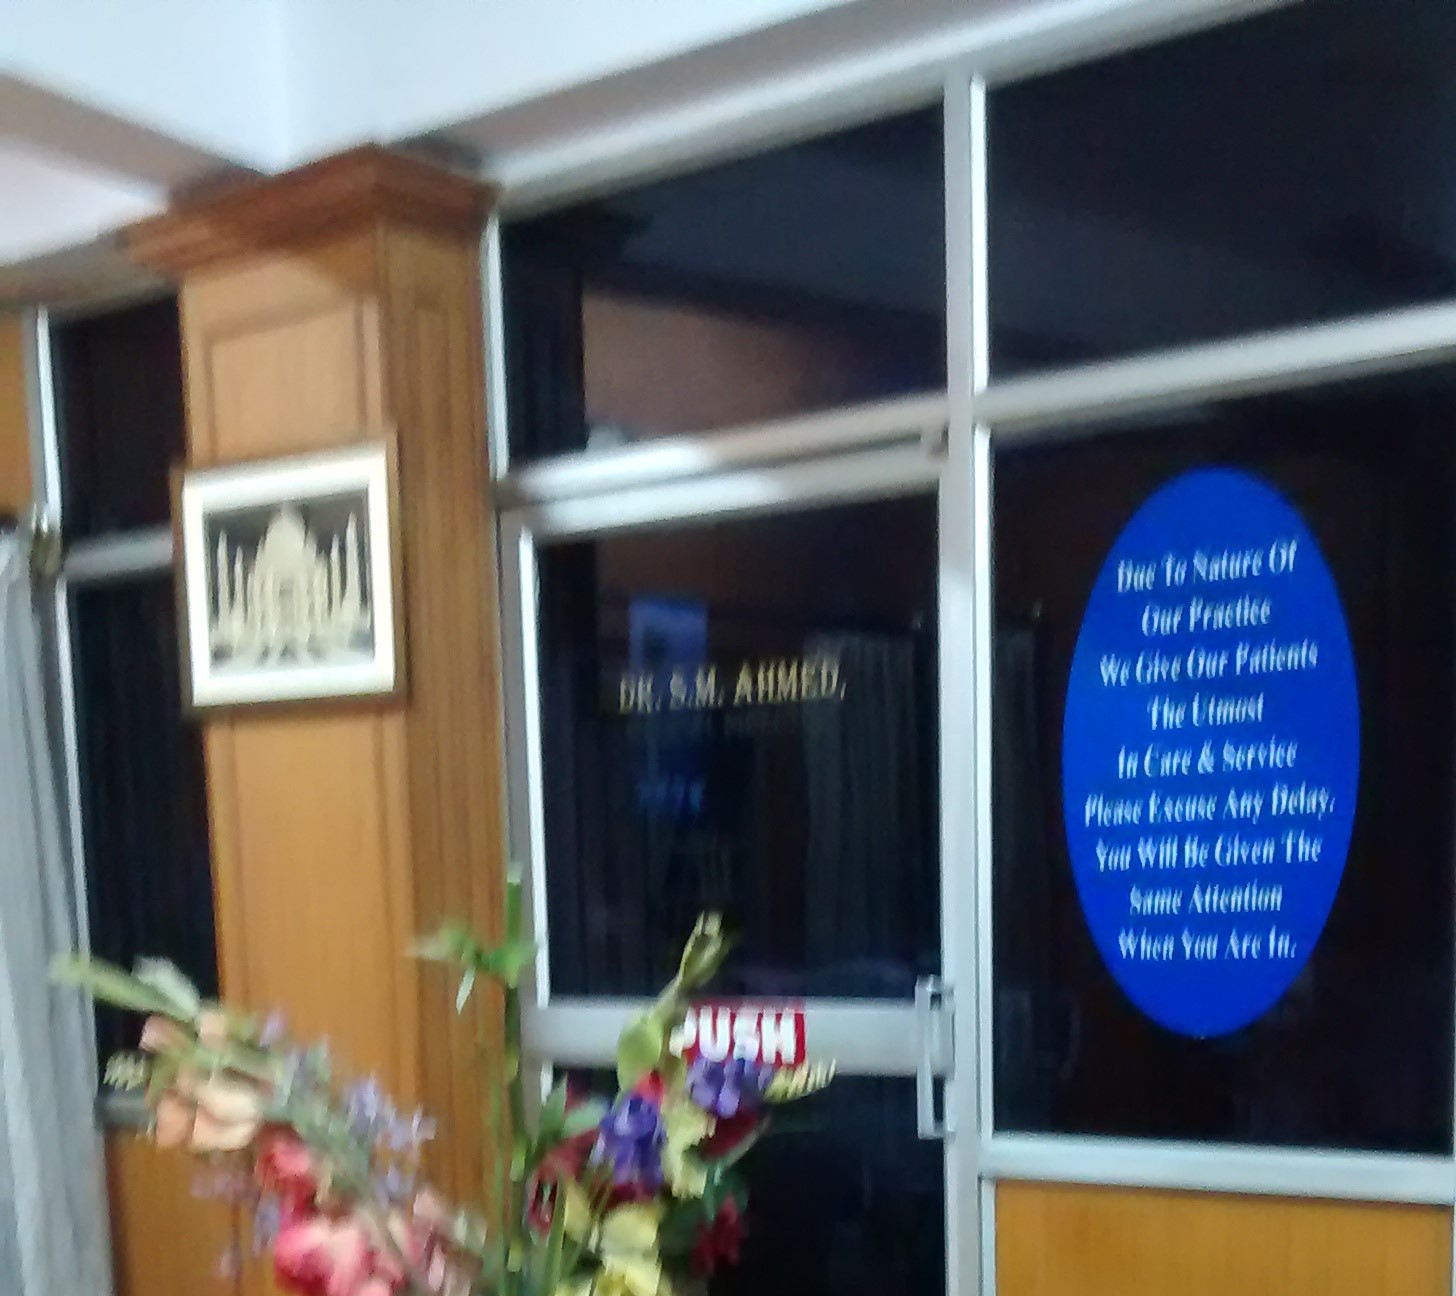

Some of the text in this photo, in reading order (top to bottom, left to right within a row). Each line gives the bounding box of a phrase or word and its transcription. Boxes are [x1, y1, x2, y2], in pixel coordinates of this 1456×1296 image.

[1117, 539, 1297, 593] Due To Nature Of
[1141, 594, 1271, 637] Our Practice
[1100, 637, 1319, 687] We Give Our Patients
[1147, 691, 1264, 731] The Utmost
[1118, 733, 1298, 779] In Care & Service
[1085, 792, 1143, 828] Please
[1149, 788, 1218, 824] Excuse
[1222, 786, 1265, 825] Any
[1096, 829, 1323, 873] You Will Be Given The
[1129, 878, 1283, 916] Same Attention
[1118, 927, 1175, 961] When
[1181, 927, 1219, 961] You
[1225, 927, 1263, 961] Are
